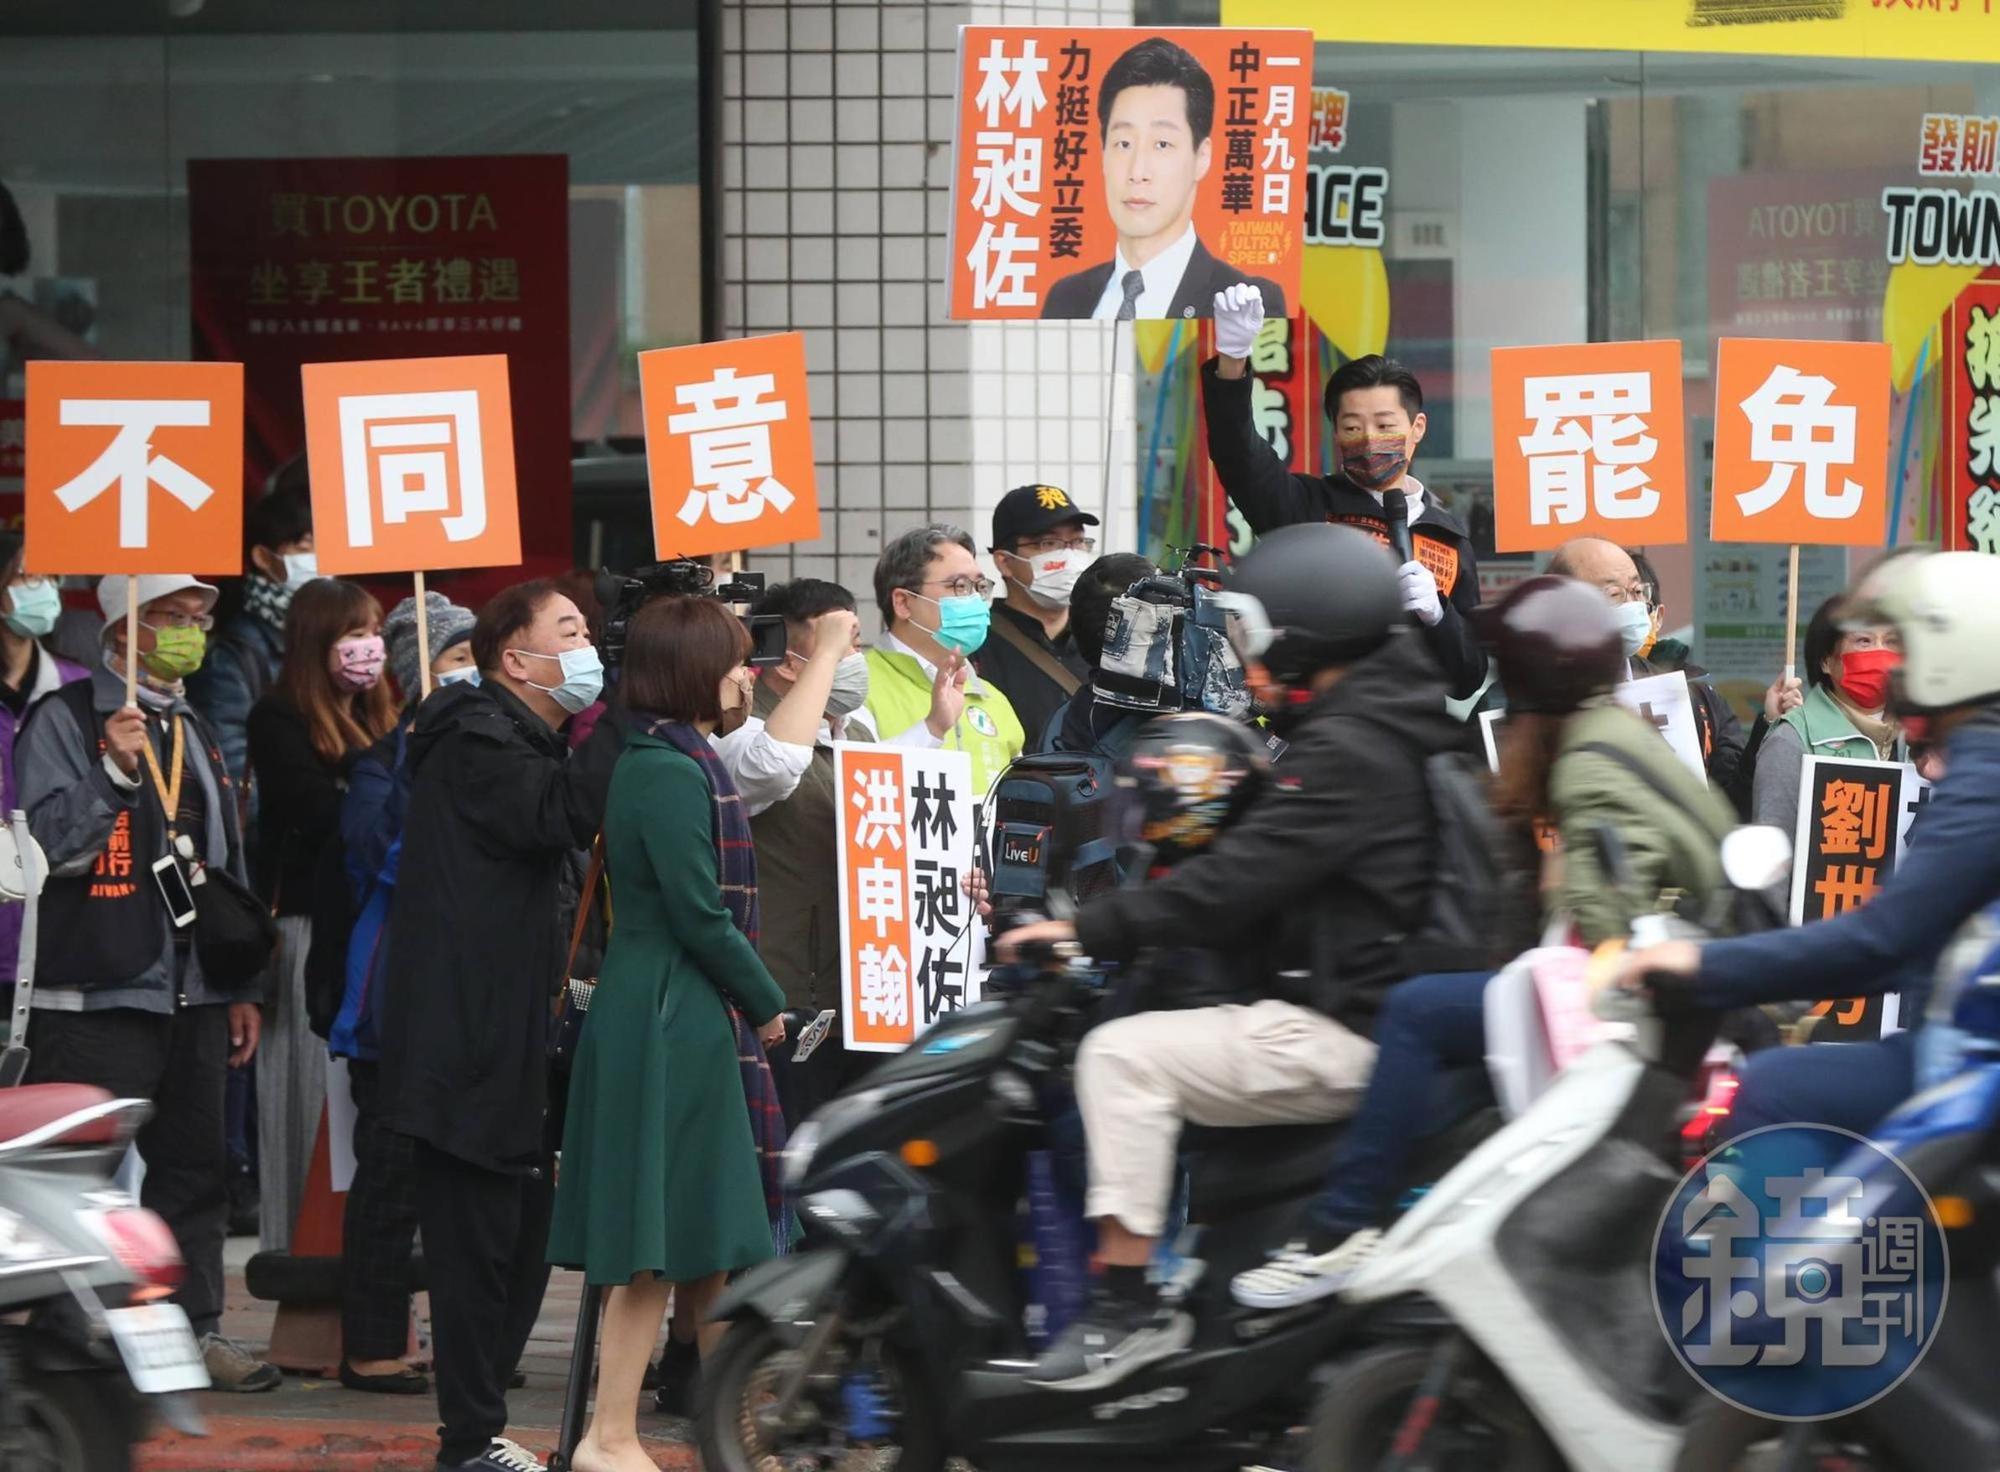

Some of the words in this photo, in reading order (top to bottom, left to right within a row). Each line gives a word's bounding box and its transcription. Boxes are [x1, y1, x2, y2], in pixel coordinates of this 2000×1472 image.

[966, 38, 1048, 310] 林昶佐
[1049, 39, 1092, 259] 力挺好立委
[1221, 41, 1260, 215] 中正萬華
[1261, 56, 1301, 215] 一月九日
[1228, 221, 1284, 236] TAIWAN
[1231, 235, 1280, 250] ULTRA
[53, 398, 215, 548] 不
[338, 389, 488, 548] 同
[667, 367, 796, 527] 意
[1518, 371, 1661, 526] 罷
[1735, 364, 1864, 519] 免
[852, 768, 909, 1027] 洪申翰
[910, 769, 963, 1025] 林昶佐
[1809, 778, 1892, 1026] 劉世
